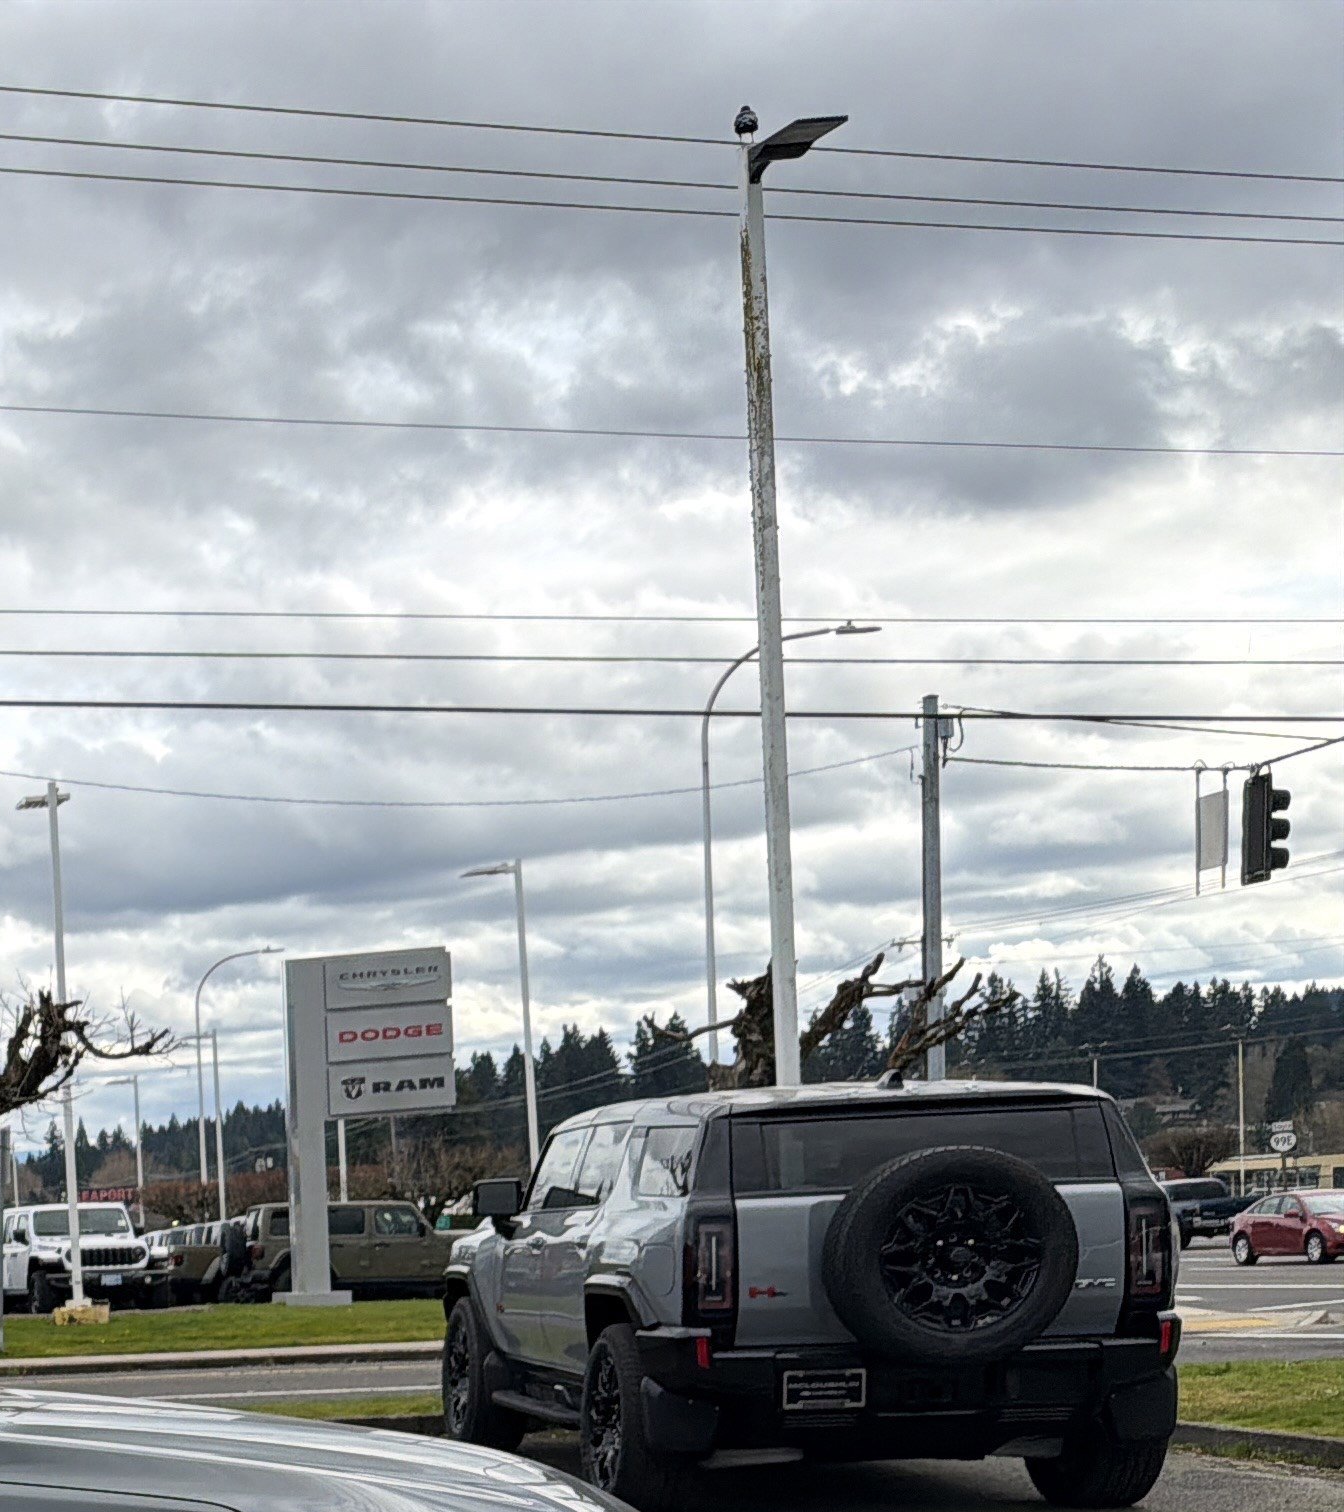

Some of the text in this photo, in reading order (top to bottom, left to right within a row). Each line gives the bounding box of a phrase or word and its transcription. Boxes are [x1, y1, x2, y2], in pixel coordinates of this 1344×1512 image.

[338, 965, 440, 981] CHRYSLER
[338, 1022, 444, 1044] DODGE
[371, 1075, 446, 1094] RAM
[1273, 1135, 1293, 1147] 99E
